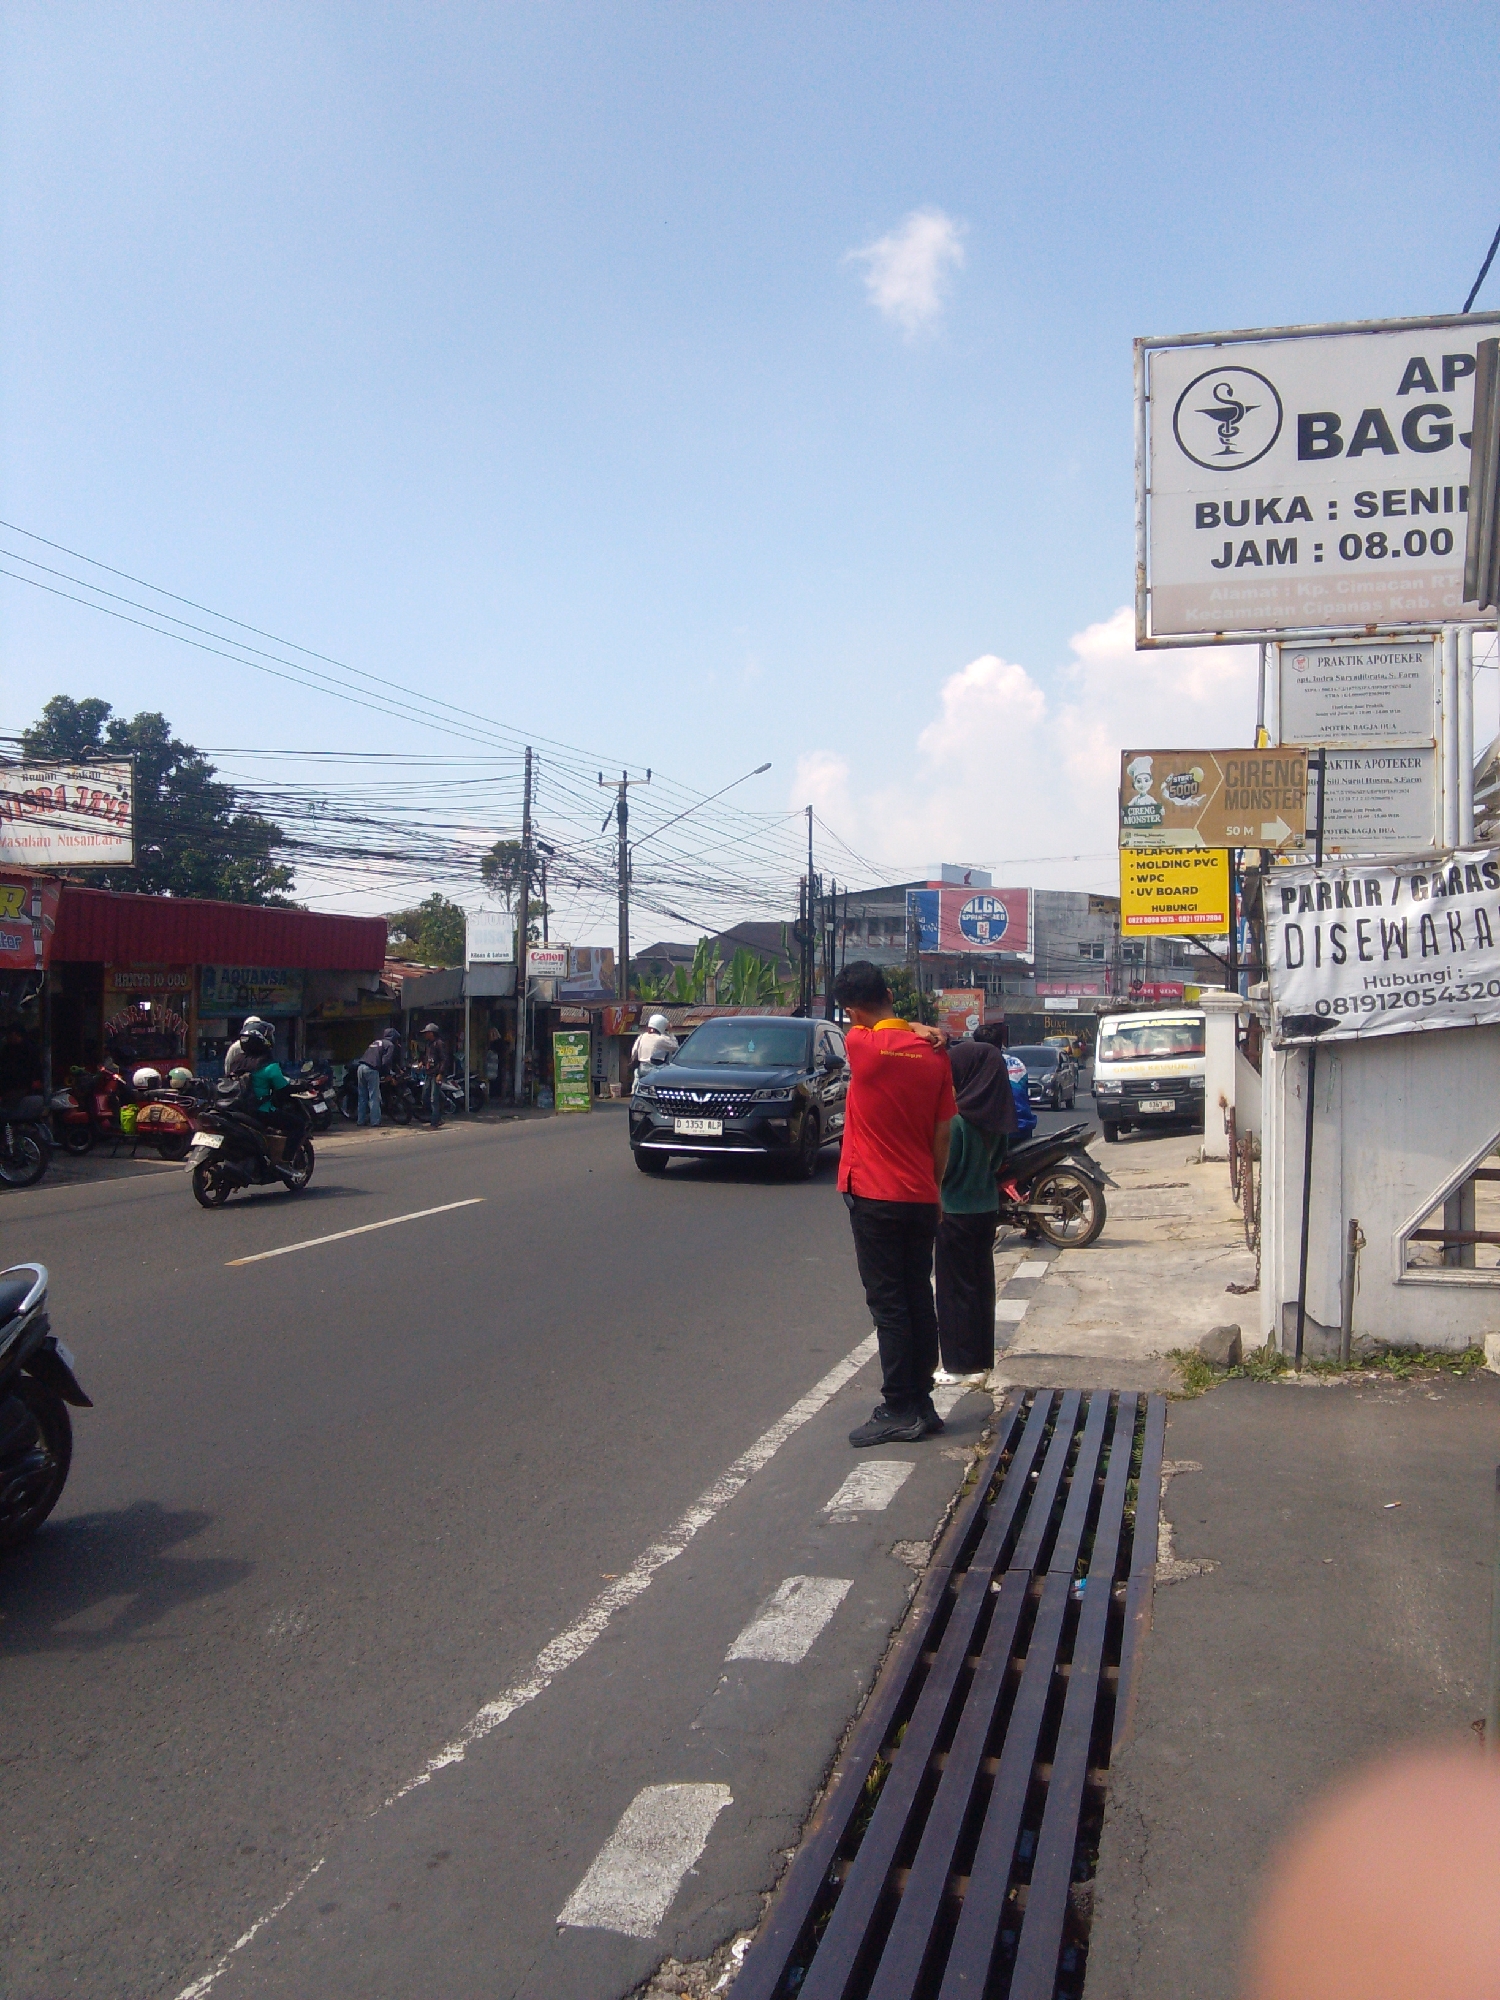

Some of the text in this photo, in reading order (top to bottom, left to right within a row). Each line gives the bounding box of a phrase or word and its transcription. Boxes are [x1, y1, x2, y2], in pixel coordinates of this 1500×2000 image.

[1297, 403, 1473, 461] BAG
[1195, 495, 1313, 530] BUKA
[1328, 499, 1338, 521] :
[1210, 528, 1454, 569] JAM : 08.00
[1209, 586, 1278, 602] Alamat
[1297, 583, 1329, 600] Kp.
[1337, 578, 1423, 594] Cimacan
[1185, 605, 1296, 622] Kecamatan
[1302, 600, 1382, 617] Cipanas
[1389, 595, 1435, 609] Kab.
[1317, 652, 1423, 668] PRAKTIK APOTEKER
[1364, 757, 1422, 770] APOTEKER
[1225, 759, 1304, 788] CIRENG
[1168, 783, 1199, 798] 5000
[1224, 788, 1304, 810] MONSTER
[1127, 805, 1156, 815] CIRENG
[1123, 814, 1161, 825] MONSTER
[1225, 826, 1254, 836] 50 M
[57, 833, 123, 847] Nusantara
[1136, 858, 1218, 870] MOLDING PVC
[1136, 874, 1165, 883] WPC
[1136, 886, 1199, 896] UV BOARD
[1280, 877, 1383, 915] PARKIR
[1410, 860, 1500, 902] GARAS
[962, 896, 1005, 913] ALGA
[1151, 903, 1198, 912] HUBUNGI
[1284, 906, 1500, 970] DISEWAKA
[531, 951, 564, 961] Canon
[1363, 965, 1452, 990] Hubungi
[1315, 978, 1500, 1017] 081912054320
[1044, 1015, 1068, 1028] BUMI
[676, 1119, 682, 1129] D
